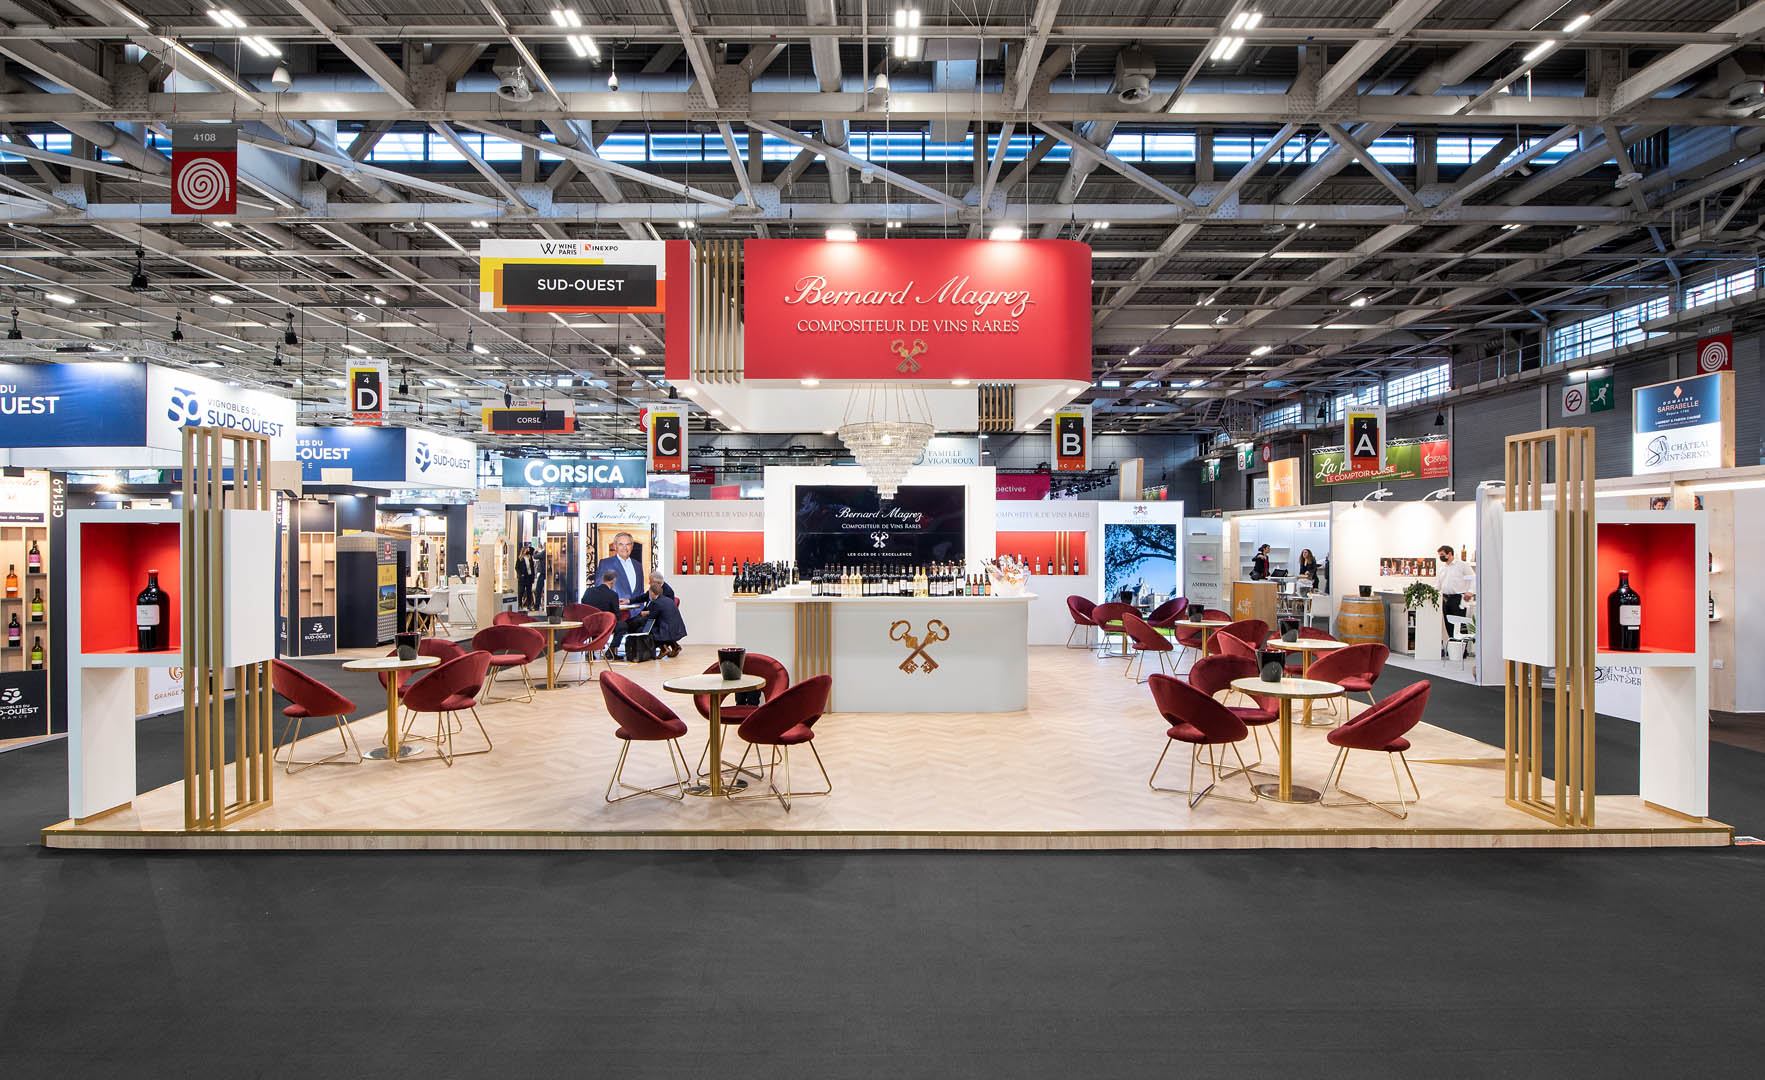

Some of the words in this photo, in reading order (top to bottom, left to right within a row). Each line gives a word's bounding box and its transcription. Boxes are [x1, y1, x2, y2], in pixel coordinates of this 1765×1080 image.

[193, 133, 216, 142] 4108
[537, 279, 625, 292] SUD-OUEST
[784, 275, 915, 305] Bernard
[916, 275, 1036, 318] Magrez
[797, 319, 906, 333] COMPOSITEUR
[910, 319, 929, 333] DE
[932, 319, 968, 333] VINS
[971, 319, 1020, 333] RARES
[207, 398, 250, 415] VIGNOBLES
[357, 387, 378, 410] D
[1657, 400, 1699, 413] SARRABELLE
[207, 409, 284, 438] SUD-OUEST
[311, 439, 324, 447] DU
[657, 432, 678, 456] C
[1062, 433, 1081, 456] B
[1353, 433, 1377, 456] A
[433, 454, 471, 470] SUD-OUEST
[928, 457, 975, 465] VIGOUROUX
[524, 460, 625, 487] CORSICA
[1326, 475, 1334, 483] LE
[1334, 469, 1371, 482] COMPTOIR
[52, 478, 64, 518] CE114-9
[835, 506, 881, 519] Bernard
[881, 506, 924, 522] Magrez
[154, 687, 180, 700] GRANGE
